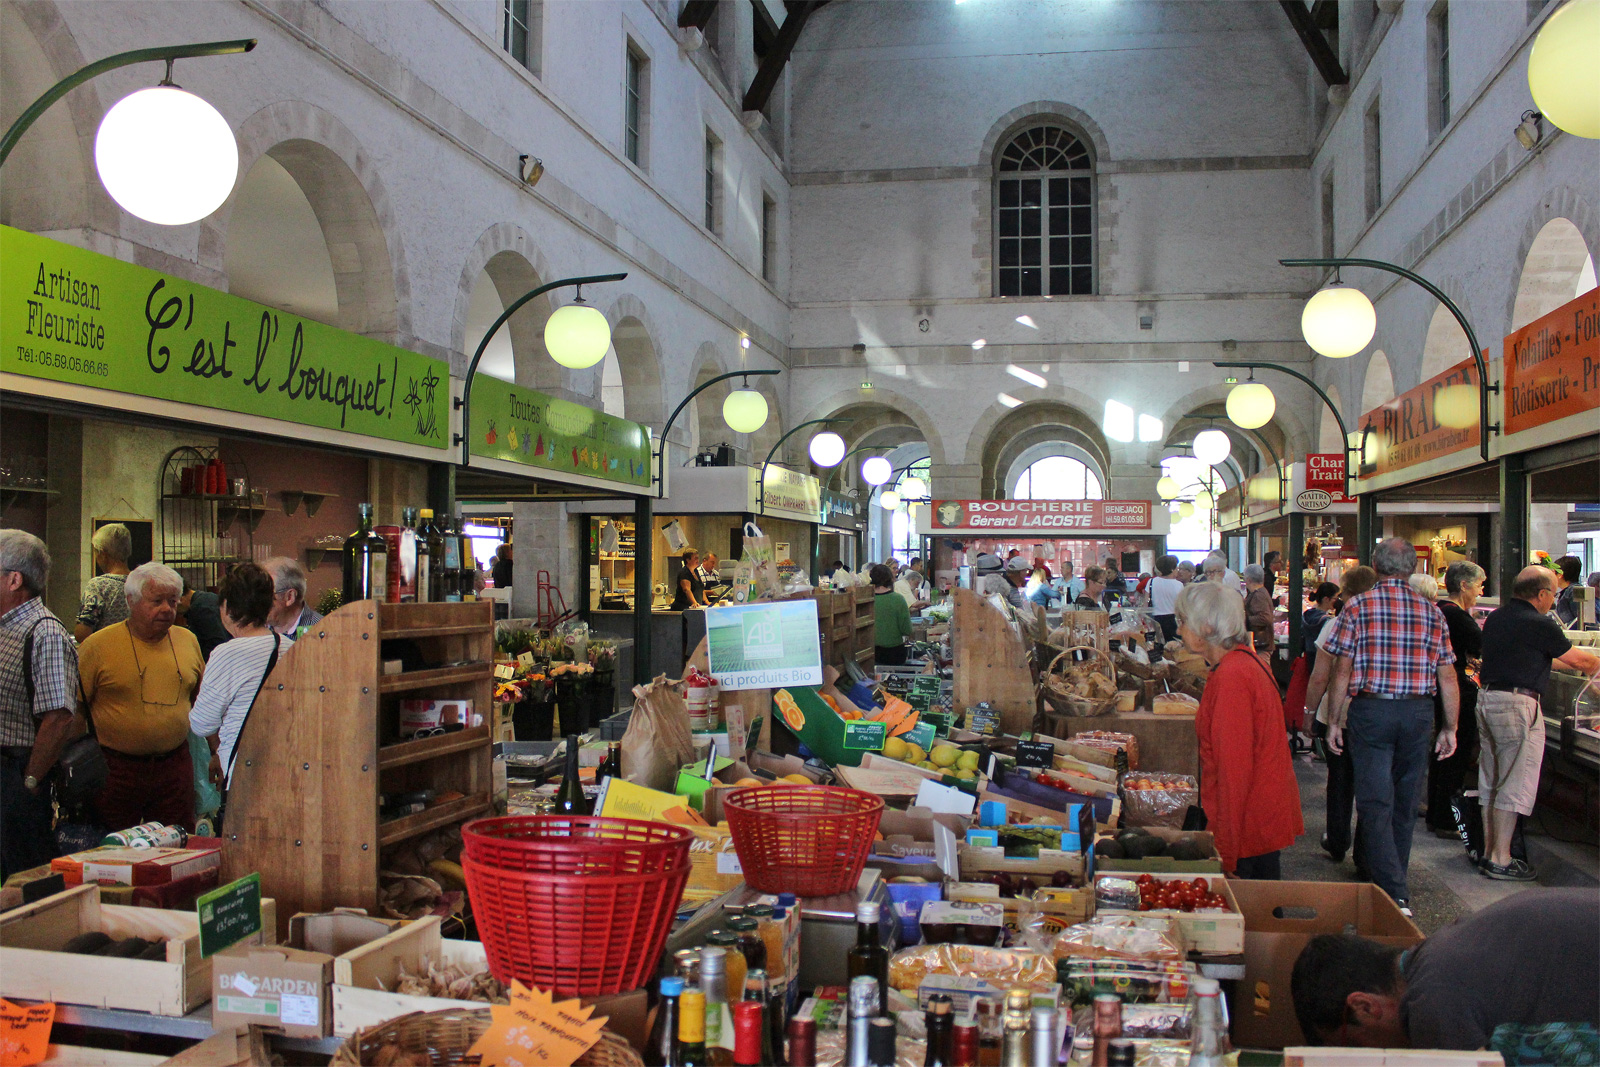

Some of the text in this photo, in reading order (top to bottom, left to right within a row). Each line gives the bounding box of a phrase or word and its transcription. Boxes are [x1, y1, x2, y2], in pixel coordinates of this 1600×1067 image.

[33, 262, 101, 311] Artisan
[25, 299, 105, 351] Fleuriste
[145, 278, 236, 379] C'est
[1513, 327, 1562, 372] Volailles
[1384, 363, 1476, 449] BIRA
[1511, 367, 1570, 418] Rôtisserie
[509, 393, 541, 424] Toutes
[968, 502, 1094, 512] BOUCHERIE
[1105, 505, 1144, 514] BENEJACQ
[1300, 500, 1328, 508] ARTISAN
[969, 514, 1093, 527] Gérard LACOSTE
[746, 621, 776, 645] AB
[720, 670, 812, 688] ici produits Bio
[219, 973, 318, 996] BIGARDEN
